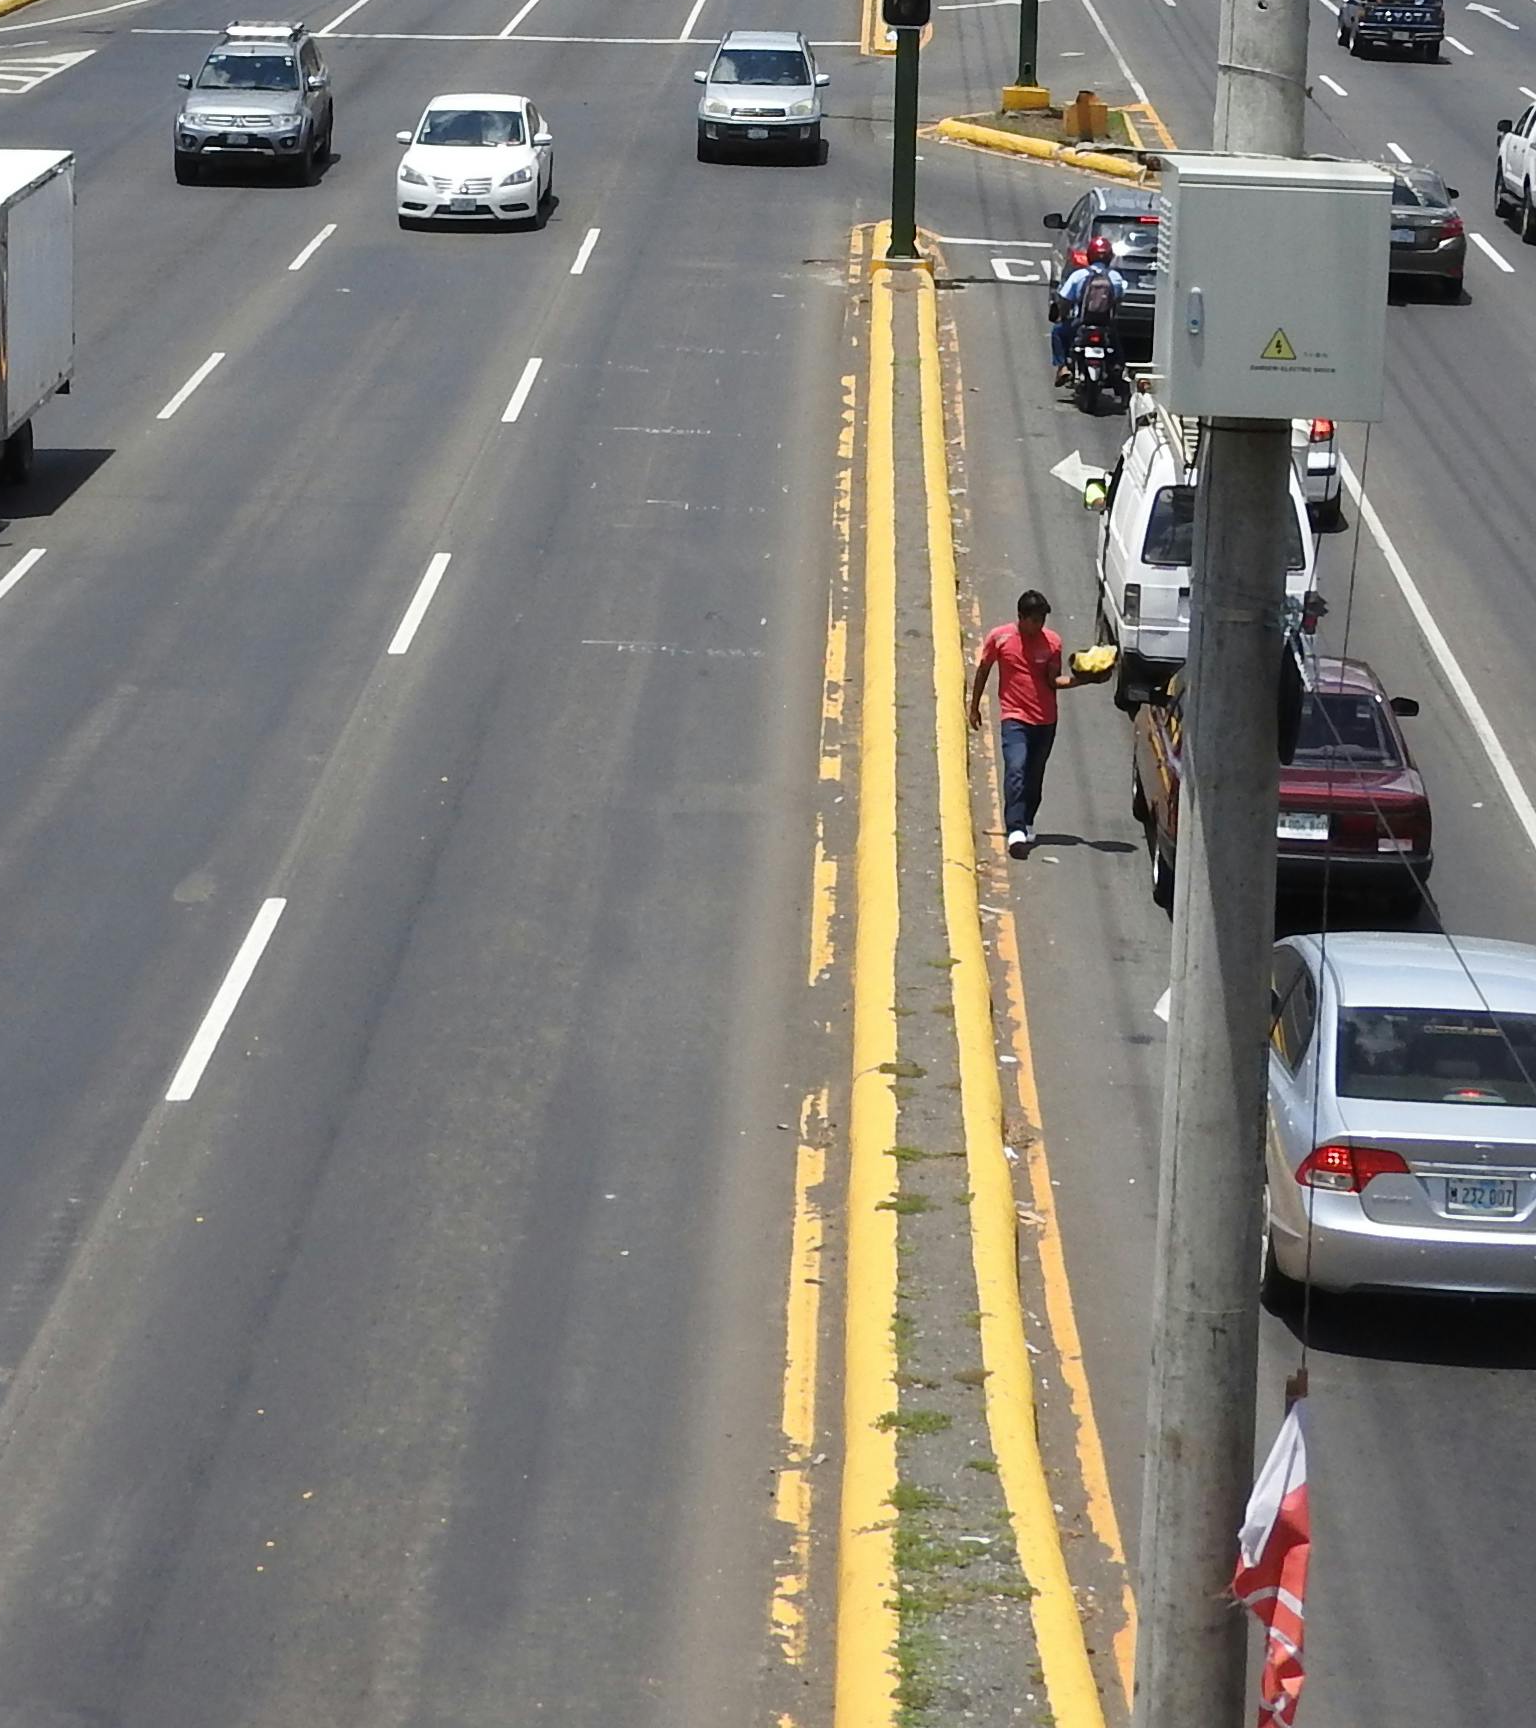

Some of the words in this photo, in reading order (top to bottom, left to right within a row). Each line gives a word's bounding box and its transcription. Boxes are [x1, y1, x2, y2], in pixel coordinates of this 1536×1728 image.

[1374, 10, 1433, 22] TOYOTA
[1462, 1186, 1484, 1205] 232
[1489, 1188, 1513, 1206] 007
